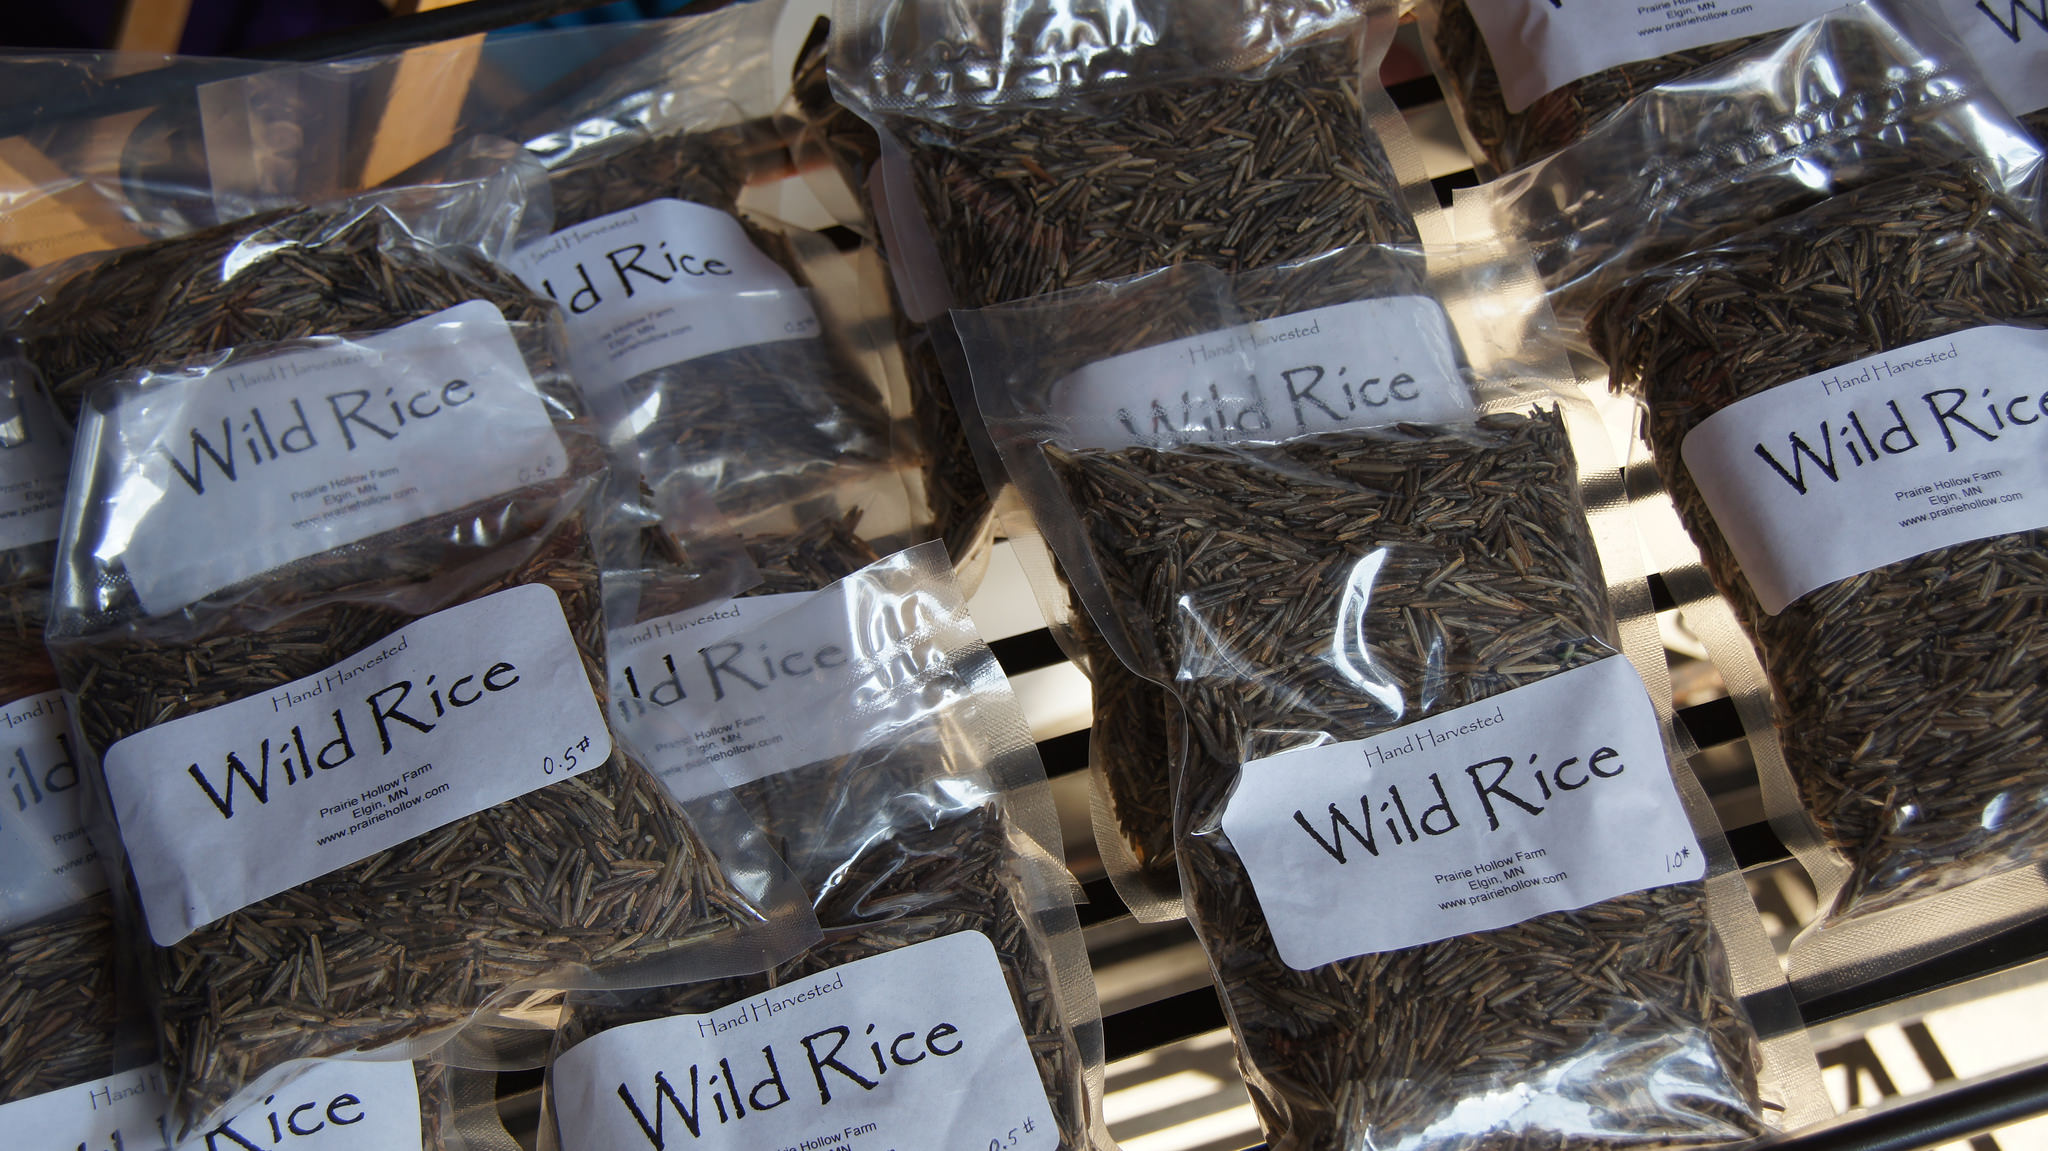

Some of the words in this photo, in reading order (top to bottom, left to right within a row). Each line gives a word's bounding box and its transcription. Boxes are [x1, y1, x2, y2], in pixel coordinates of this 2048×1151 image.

[1638, 4, 1753, 37] www.prairiehollow.com
[1667, 7, 1695, 19] Elgin,
[606, 242, 733, 298] Rice
[1239, 318, 1321, 352] Harvested
[1821, 367, 1871, 396] Hand
[1872, 342, 1959, 381] Harvested
[1281, 364, 1420, 432] Rice
[161, 399, 318, 496] Wild
[328, 377, 476, 451] Rice
[1754, 399, 1920, 495] Wild
[356, 482, 379, 496] MN
[370, 466, 400, 480] Farm
[1895, 483, 1933, 502] Prairie
[1935, 474, 1972, 493] Hollow
[1973, 467, 2002, 483] Farm
[1898, 490, 2024, 528] www.prairiehollow.com
[1928, 491, 1962, 508] Elgin,
[1962, 485, 1984, 500] MN
[653, 604, 741, 639] Harvested
[272, 680, 323, 713] Hand
[325, 635, 410, 691] Harvested
[614, 654, 687, 723] ild
[697, 640, 849, 702] Rice
[187, 708, 357, 820] Wild
[366, 661, 521, 756] Rice
[694, 722, 735, 741] Hollow
[720, 732, 742, 746] MN
[1363, 738, 1415, 768] Hand
[1415, 706, 1505, 752] Harvested
[8, 733, 80, 812] ild
[319, 798, 360, 819] Prairie
[360, 778, 401, 802] Hollow
[402, 761, 433, 783] Farm
[316, 781, 450, 846] www.prairiehollow.com
[352, 801, 386, 820] Elgin,
[388, 786, 410, 803] MN
[1293, 773, 1460, 865] Wild
[1465, 746, 1625, 831] Rice
[1434, 867, 1473, 885] Prairie
[1473, 856, 1514, 875] Hollow
[1515, 847, 1547, 862] Farm
[1468, 877, 1502, 892] Elgin,
[1503, 865, 1525, 880] MN
[1437, 869, 1568, 911] www.prairiehollow.com
[697, 1006, 750, 1039] Hand
[750, 972, 845, 1024] Harvested
[90, 1083, 146, 1110] Hand
[617, 1044, 791, 1151] Wild
[800, 1022, 964, 1106] Rice
[799, 1131, 842, 1151] Hollow
[844, 1121, 878, 1140] Farm
